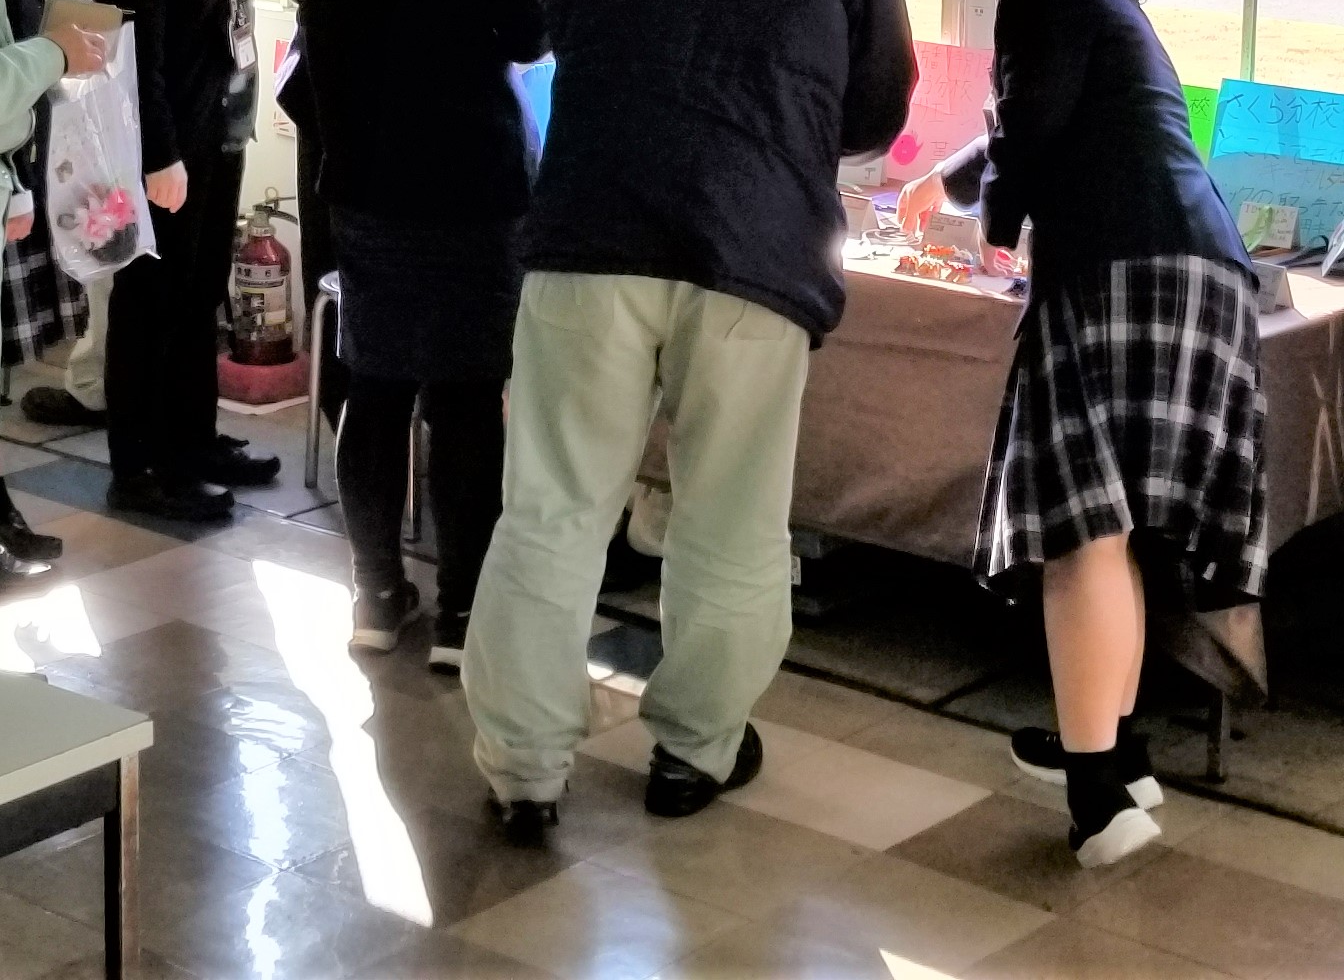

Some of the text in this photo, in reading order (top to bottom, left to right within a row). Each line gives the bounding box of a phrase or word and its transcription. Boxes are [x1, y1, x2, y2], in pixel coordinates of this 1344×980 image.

[1226, 93, 1340, 129] さくら分校
